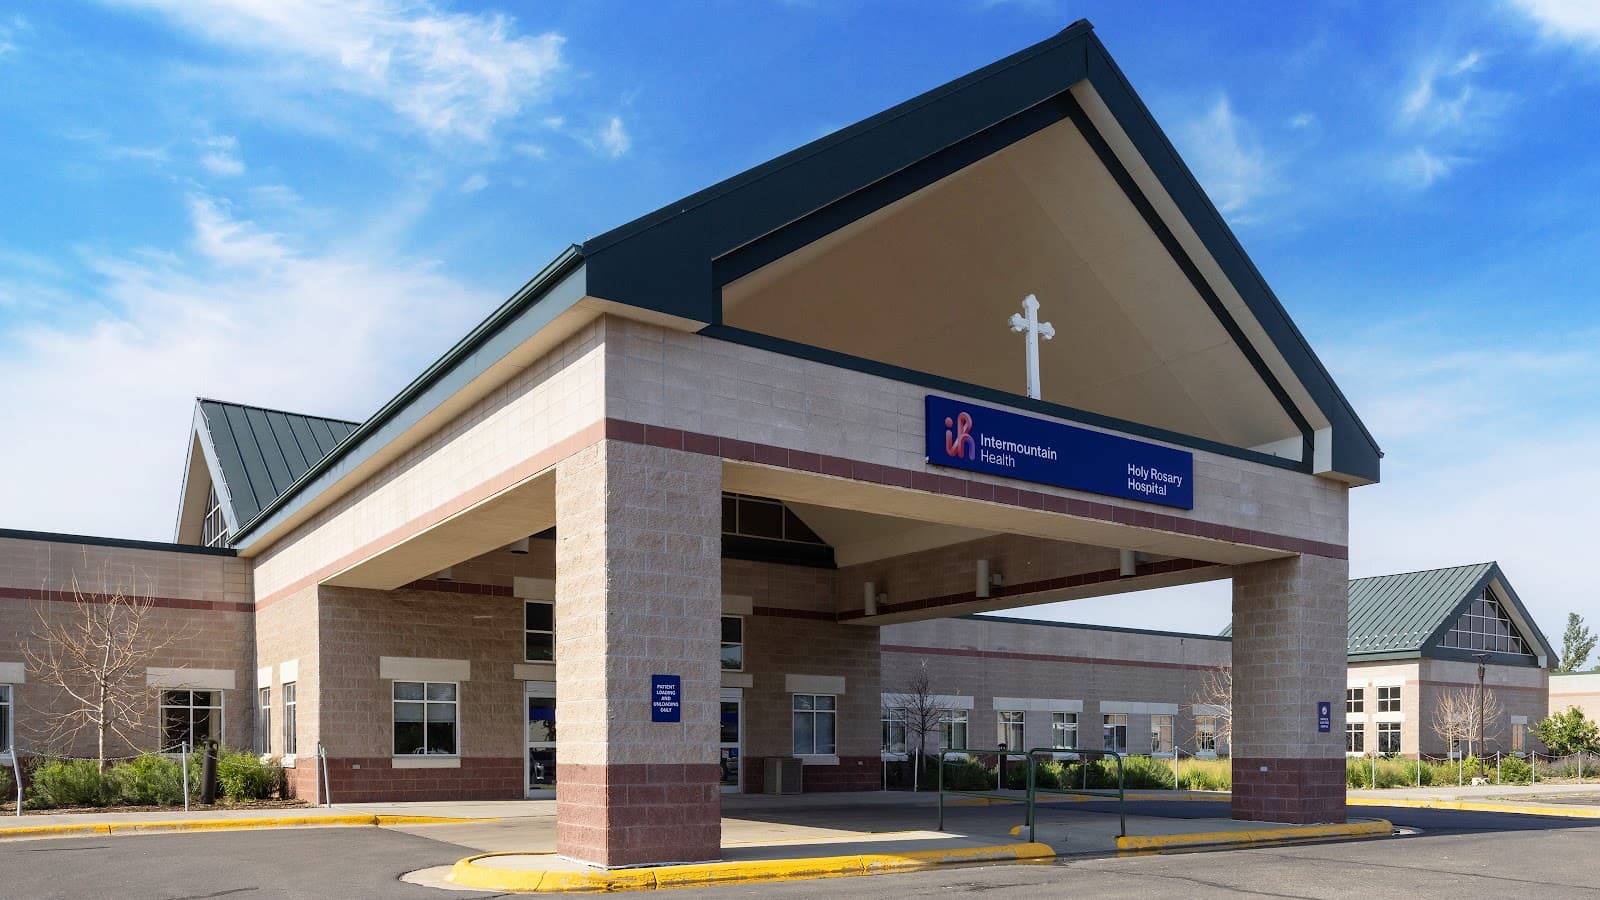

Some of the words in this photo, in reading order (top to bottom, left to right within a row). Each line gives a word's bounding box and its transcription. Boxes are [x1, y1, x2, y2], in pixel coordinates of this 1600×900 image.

[980, 433, 1057, 461] Intermountain
[980, 452, 1015, 468] Health
[1128, 463, 1148, 481] Holy
[1151, 468, 1183, 487] Rosary
[1128, 478, 1167, 496] Hospital
